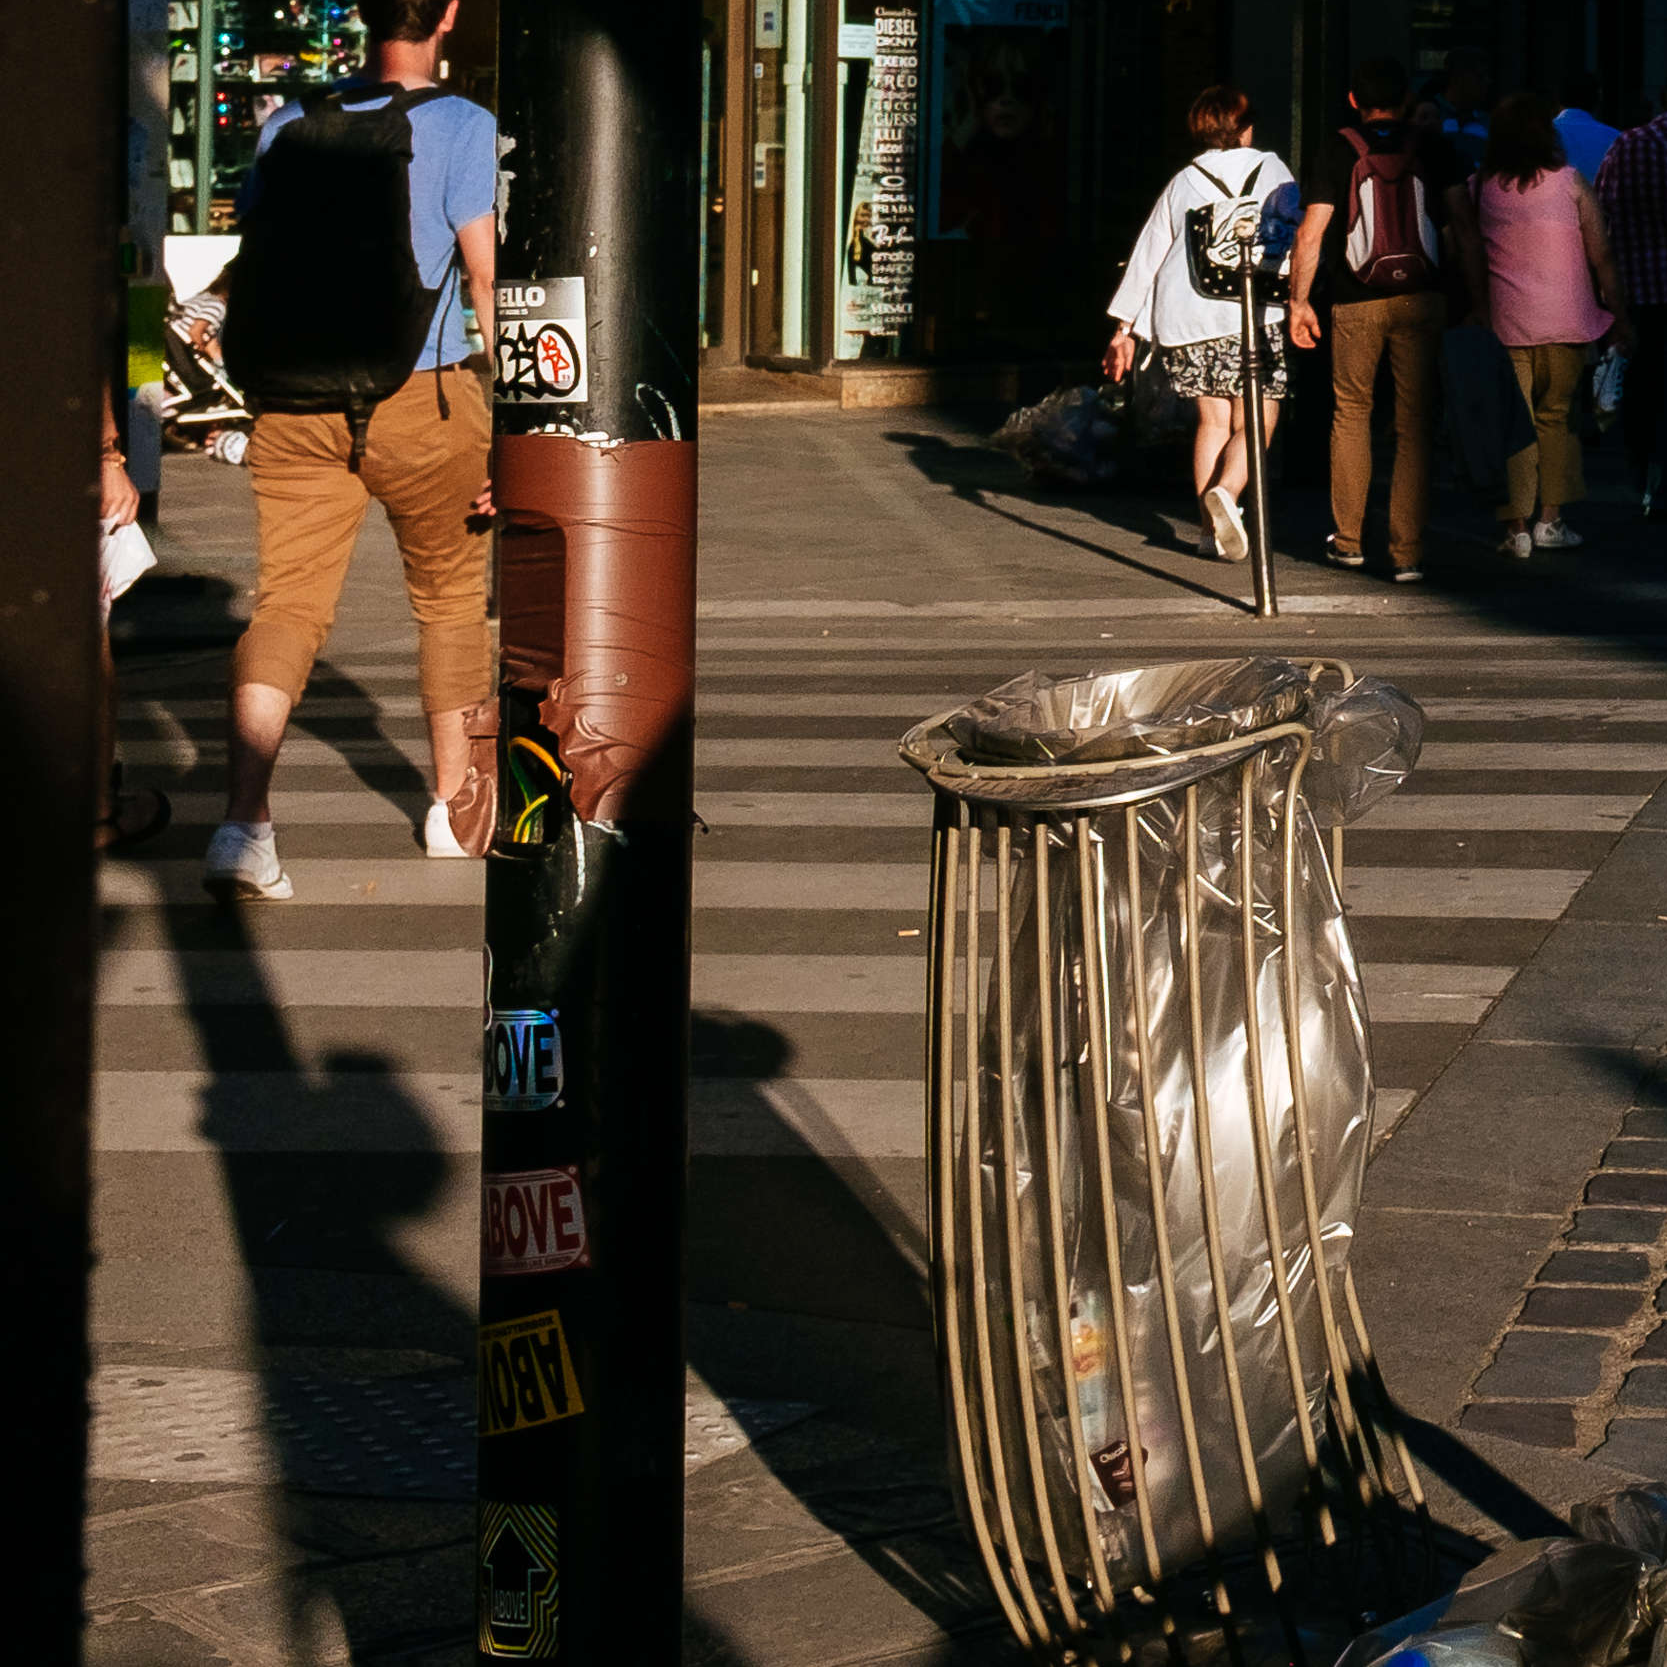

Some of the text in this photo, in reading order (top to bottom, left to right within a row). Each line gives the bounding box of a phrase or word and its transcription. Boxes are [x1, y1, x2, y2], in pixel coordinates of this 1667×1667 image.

[875, 18, 918, 36] DIESEL
[873, 113, 917, 126] GUESS
[497, 286, 546, 307] ELLO
[486, 1181, 580, 1257] BOVE
[482, 1328, 573, 1428] ABO
